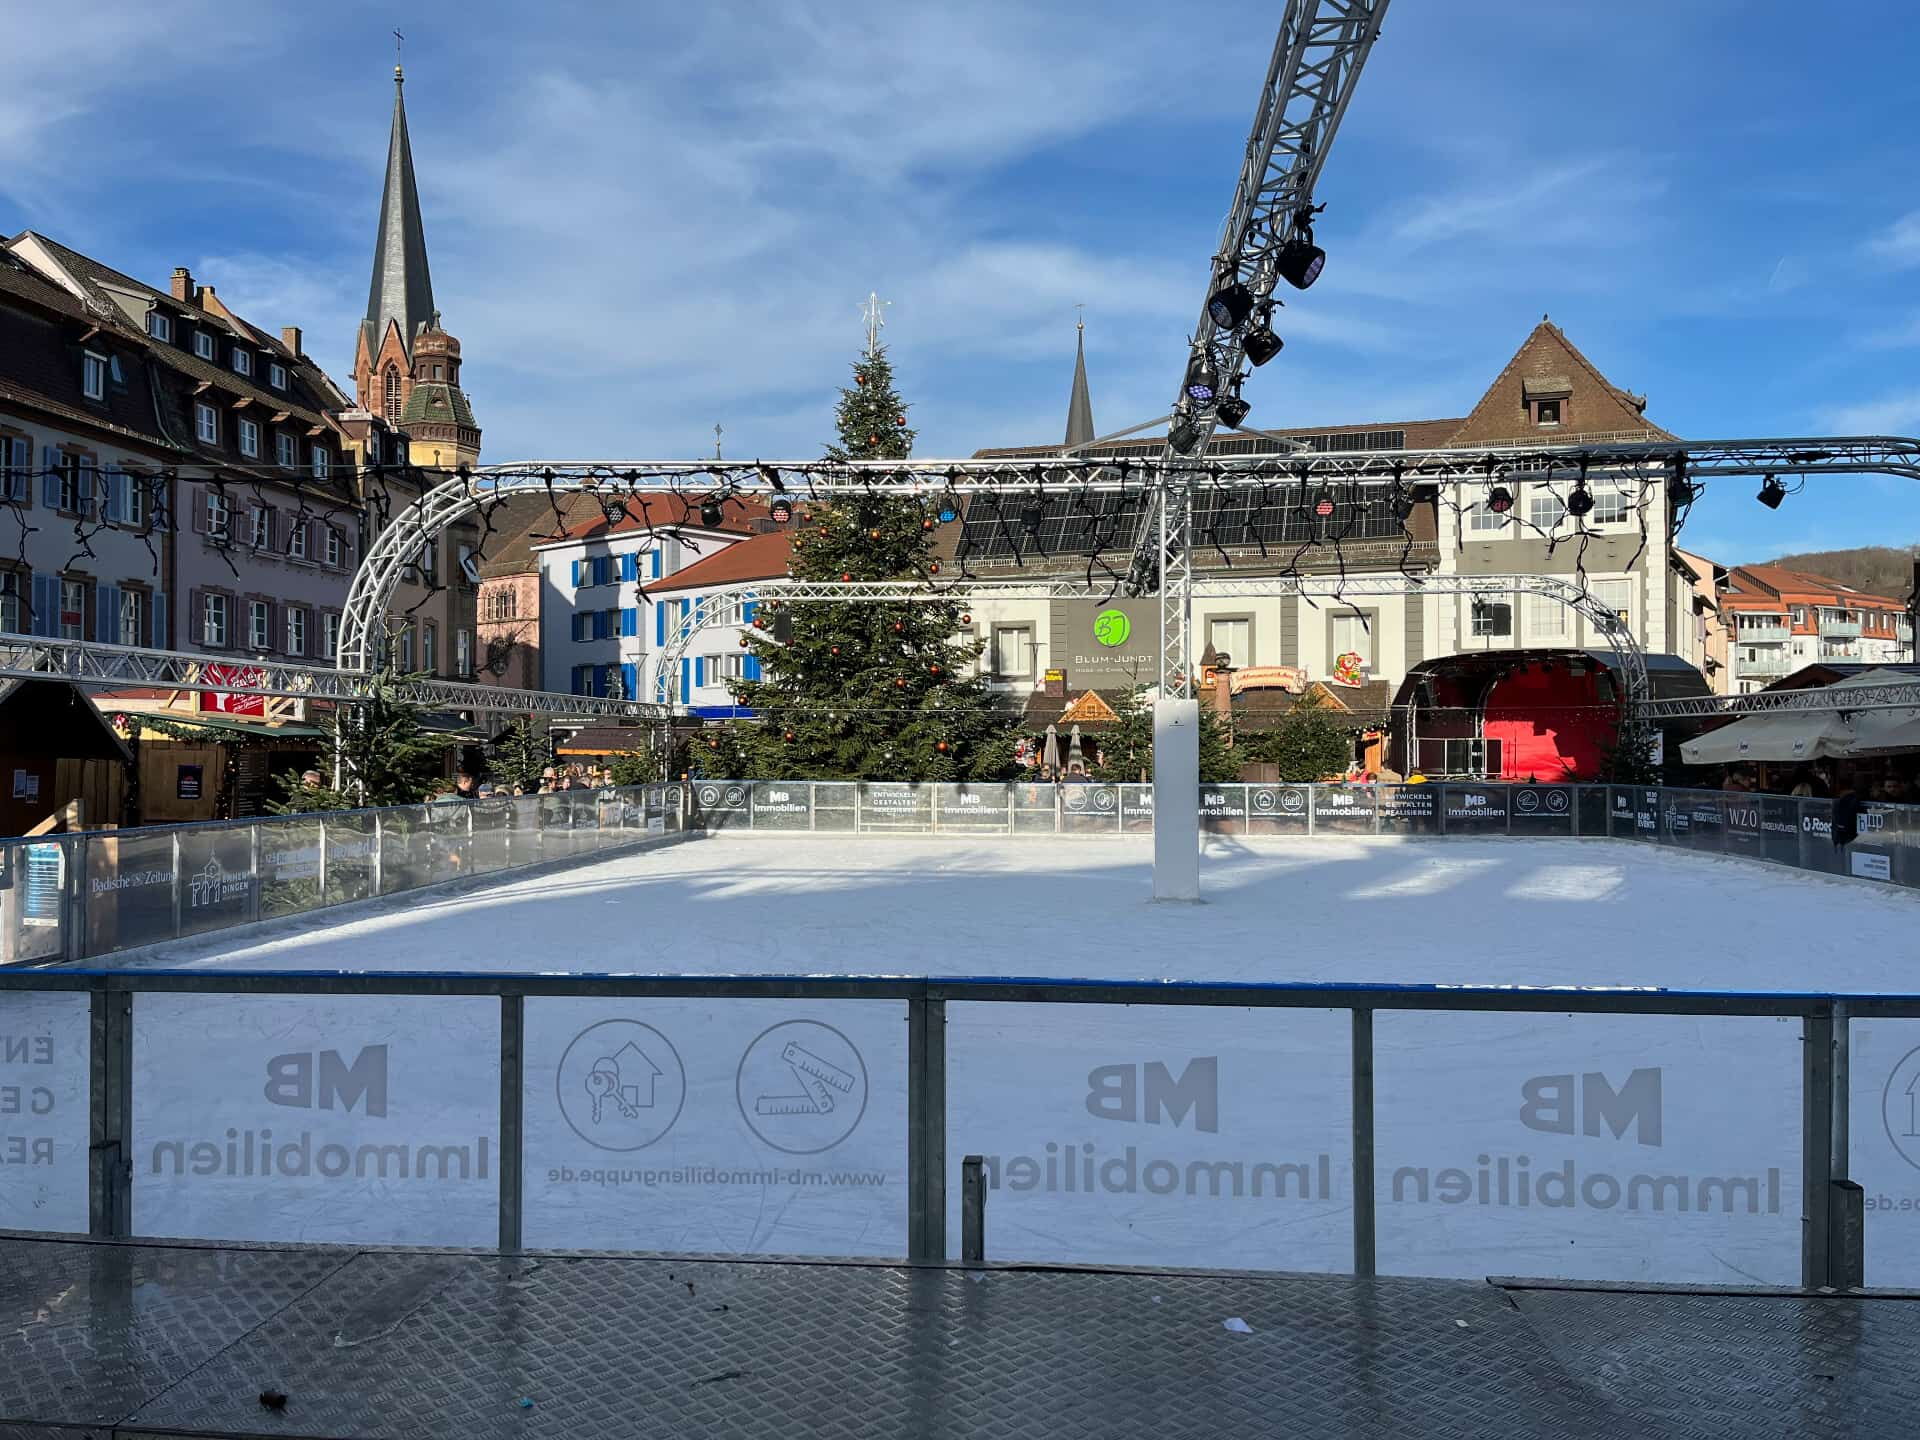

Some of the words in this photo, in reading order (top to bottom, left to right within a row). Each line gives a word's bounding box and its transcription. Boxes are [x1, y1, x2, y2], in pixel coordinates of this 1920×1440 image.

[1075, 655, 1153, 664] BLUM-JUNDT
[769, 790, 789, 803] MB
[960, 793, 981, 805] MB
[1140, 793, 1152, 806] M
[1205, 794, 1225, 806] MB
[1332, 794, 1354, 806] MB
[1465, 794, 1487, 807] MB
[754, 804, 807, 813] Immobilien
[1124, 807, 1152, 817] Immo
[1316, 807, 1373, 816] Immobilien
[1448, 808, 1505, 817] Immobilien
[1729, 807, 1757, 828] WZO
[92, 873, 130, 895] Badische
[223, 881, 248, 893] DINGEN
